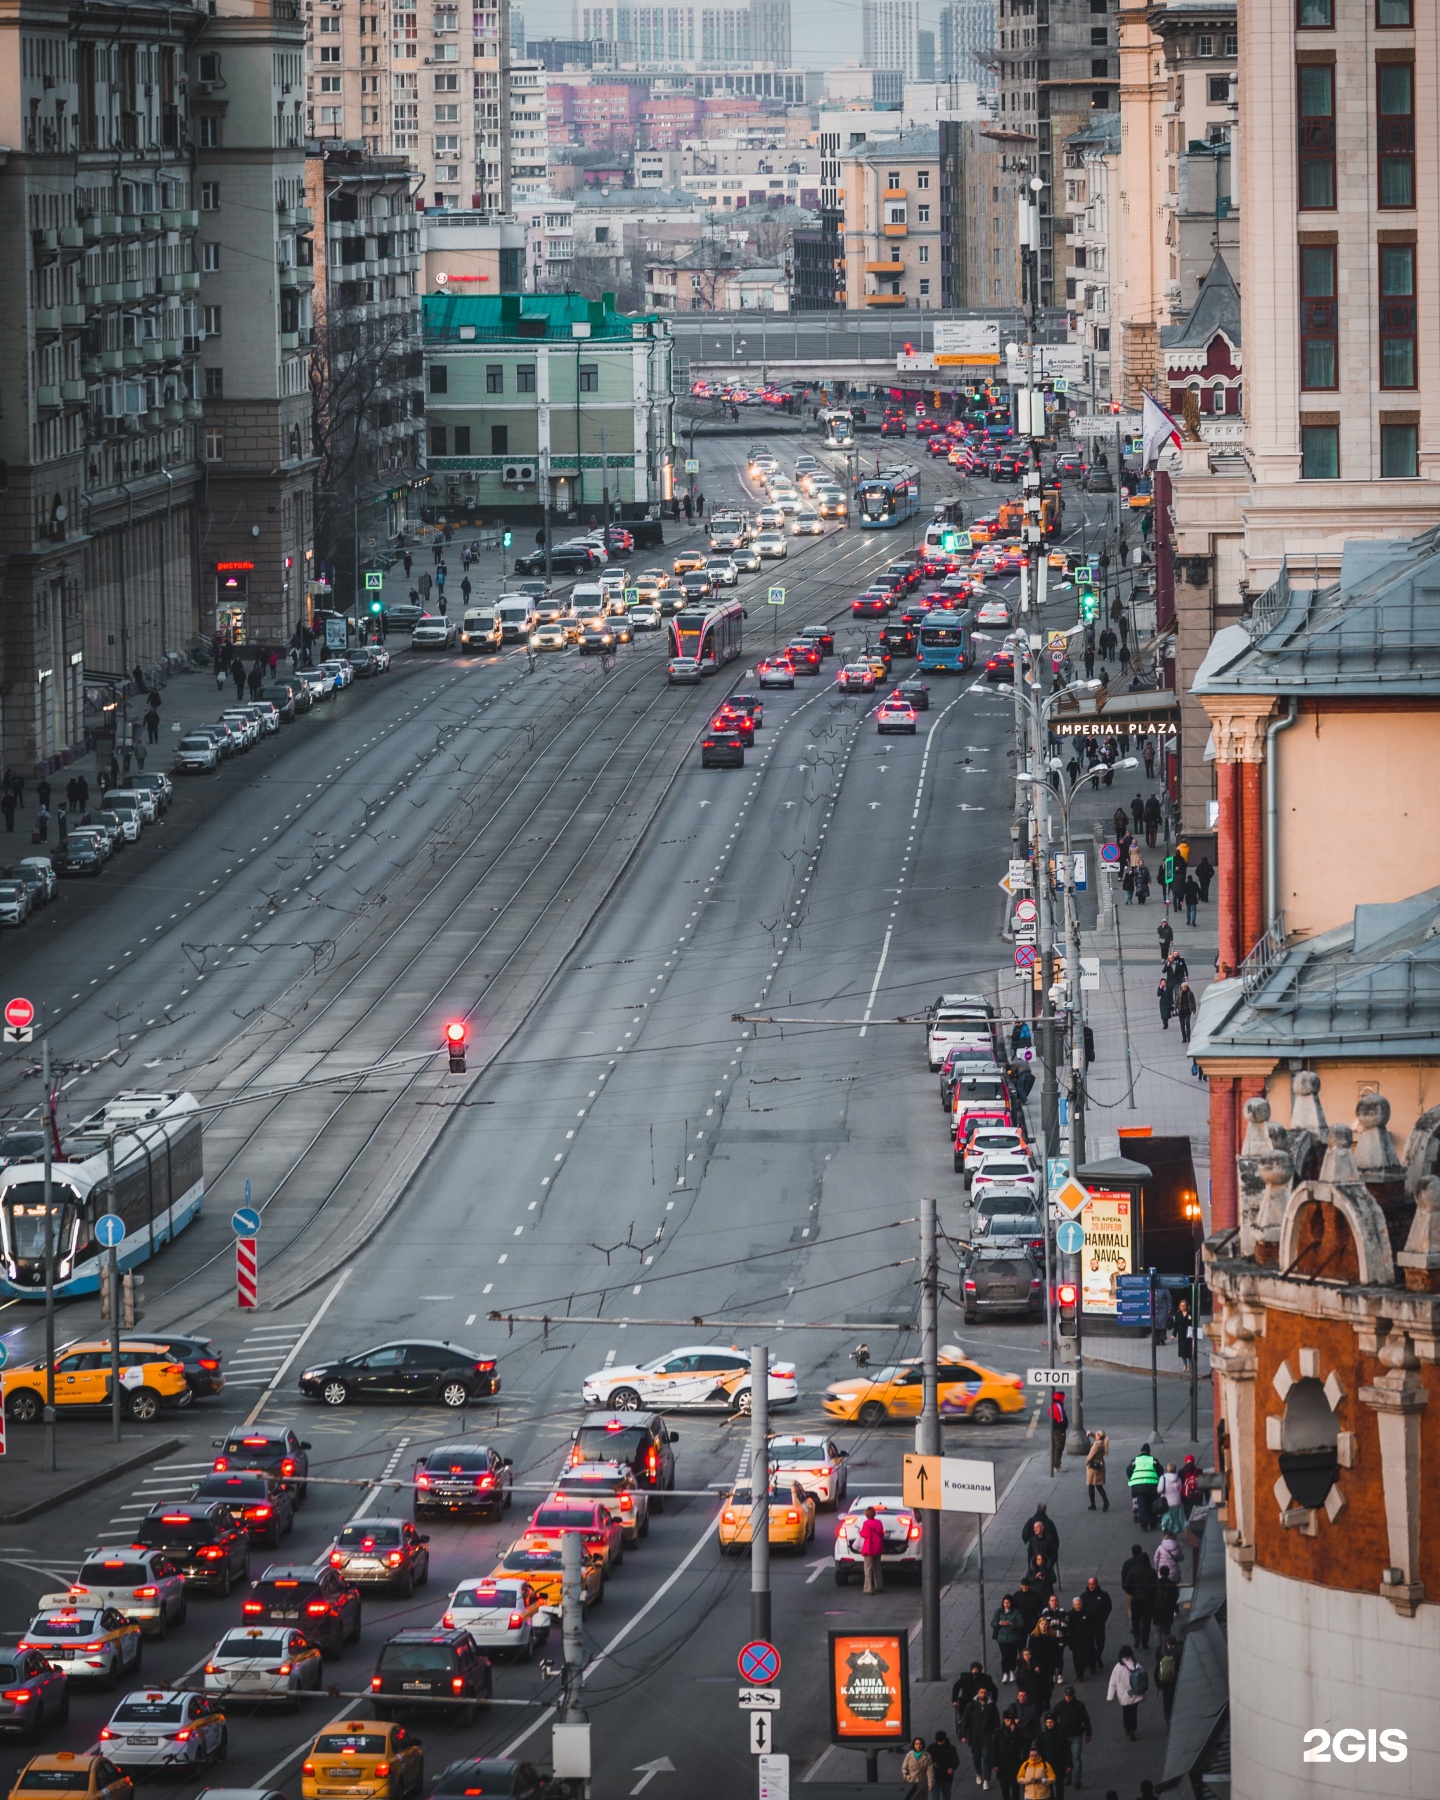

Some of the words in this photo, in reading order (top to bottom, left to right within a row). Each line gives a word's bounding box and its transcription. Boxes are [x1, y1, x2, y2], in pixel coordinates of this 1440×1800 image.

[1057, 724, 1123, 734] IMPERIAL
[1129, 724, 1176, 734] PLAZA
[1052, 1162, 1067, 1186] P
[1100, 1223, 1121, 1232] АПРЕЛЯ
[1085, 1233, 1128, 1247] HAMMALI
[1034, 1372, 1069, 1383] СТОП
[944, 1480, 950, 1489] К
[952, 1482, 991, 1491] вокзалам
[854, 1678, 883, 1686] АННА
[840, 1686, 896, 1694] КАРЕНИНА
